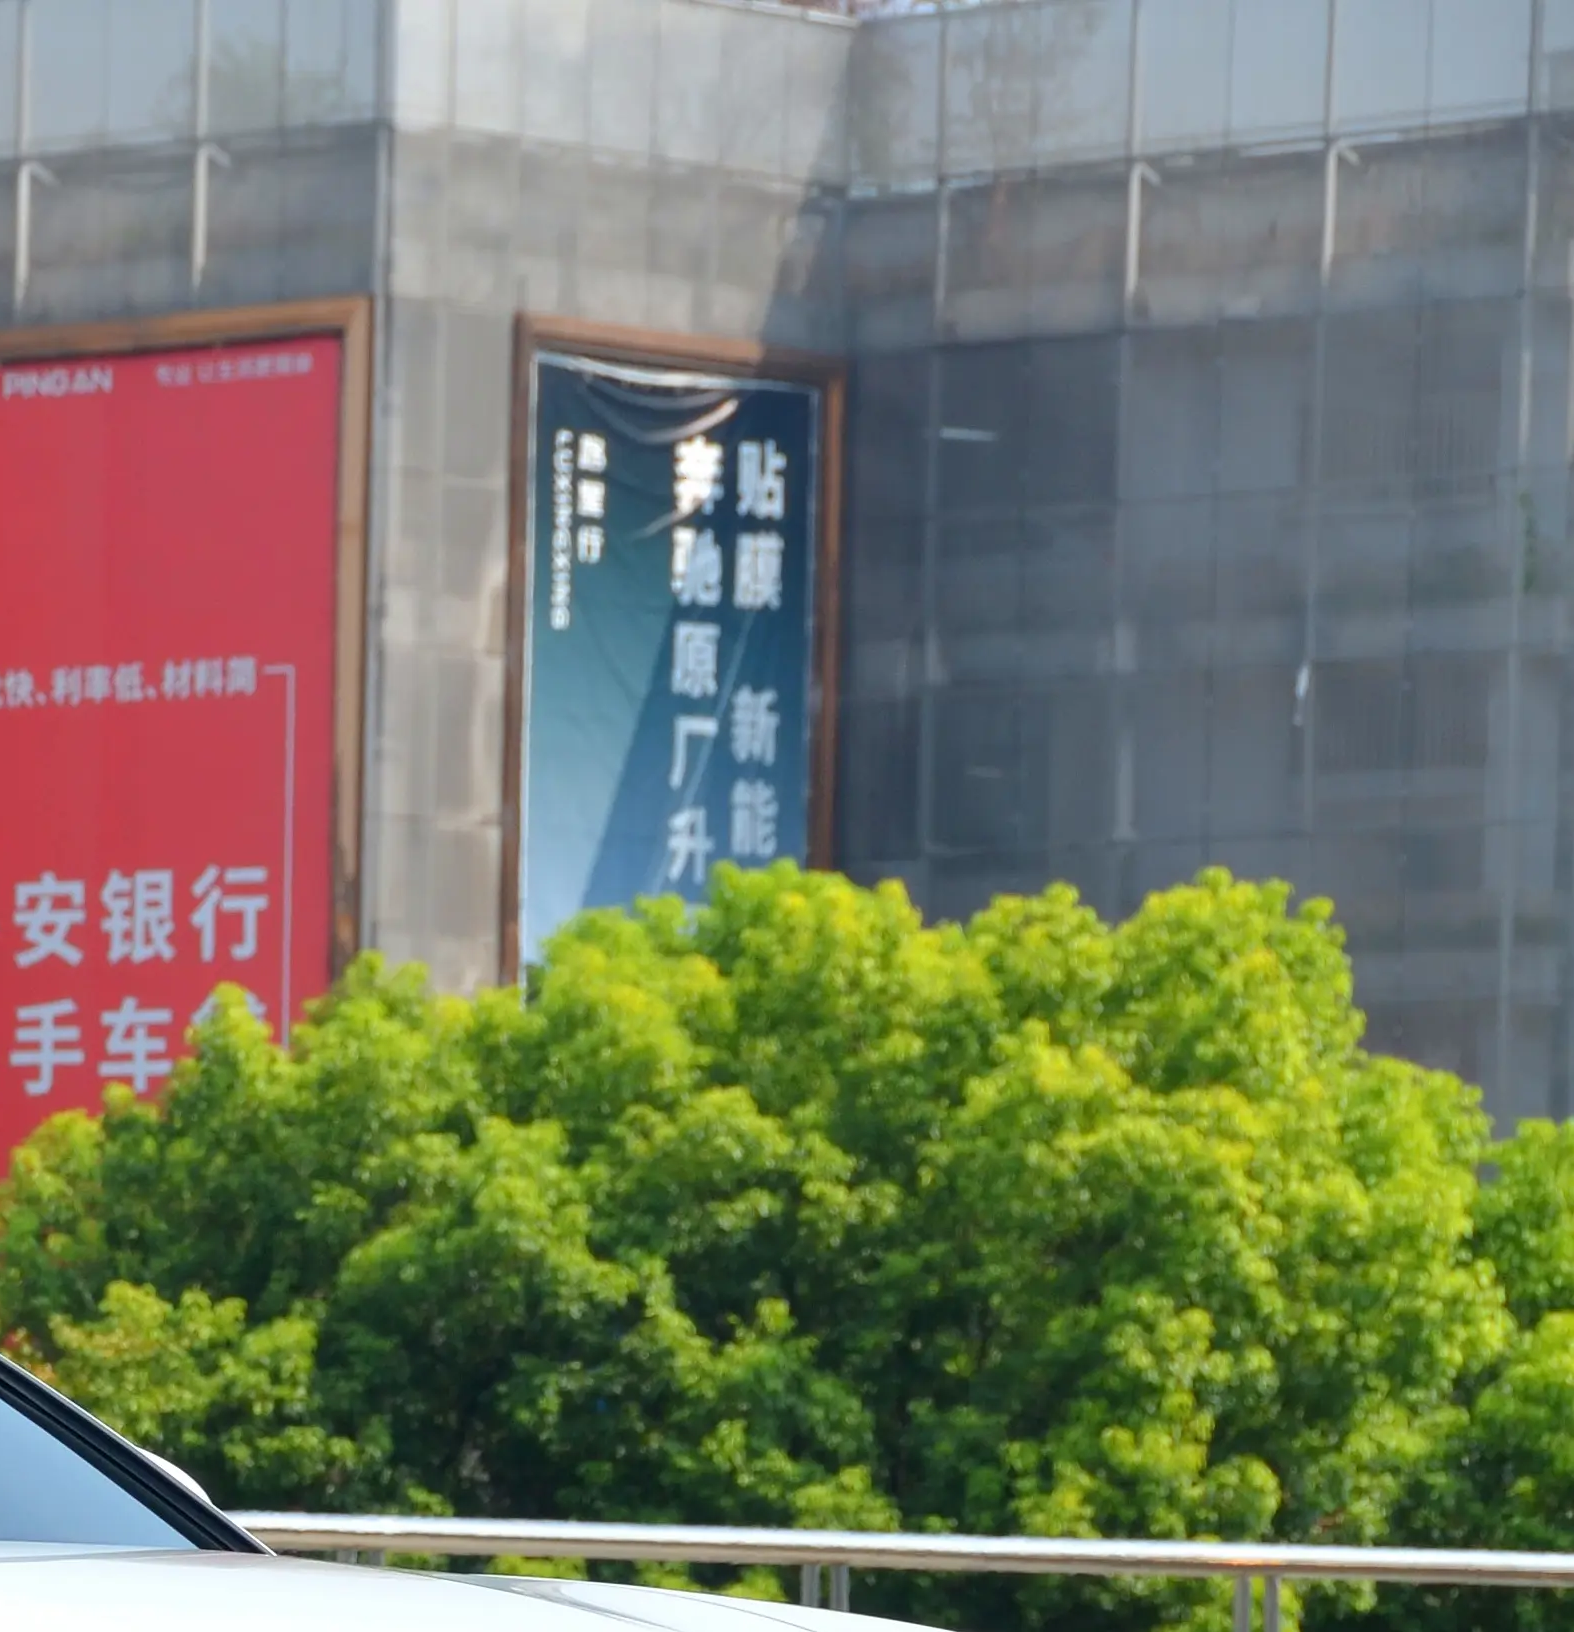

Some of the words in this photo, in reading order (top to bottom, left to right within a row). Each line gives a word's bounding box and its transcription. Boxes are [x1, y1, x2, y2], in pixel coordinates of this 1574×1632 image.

[666, 434, 726, 935] 奔驰原厂升
